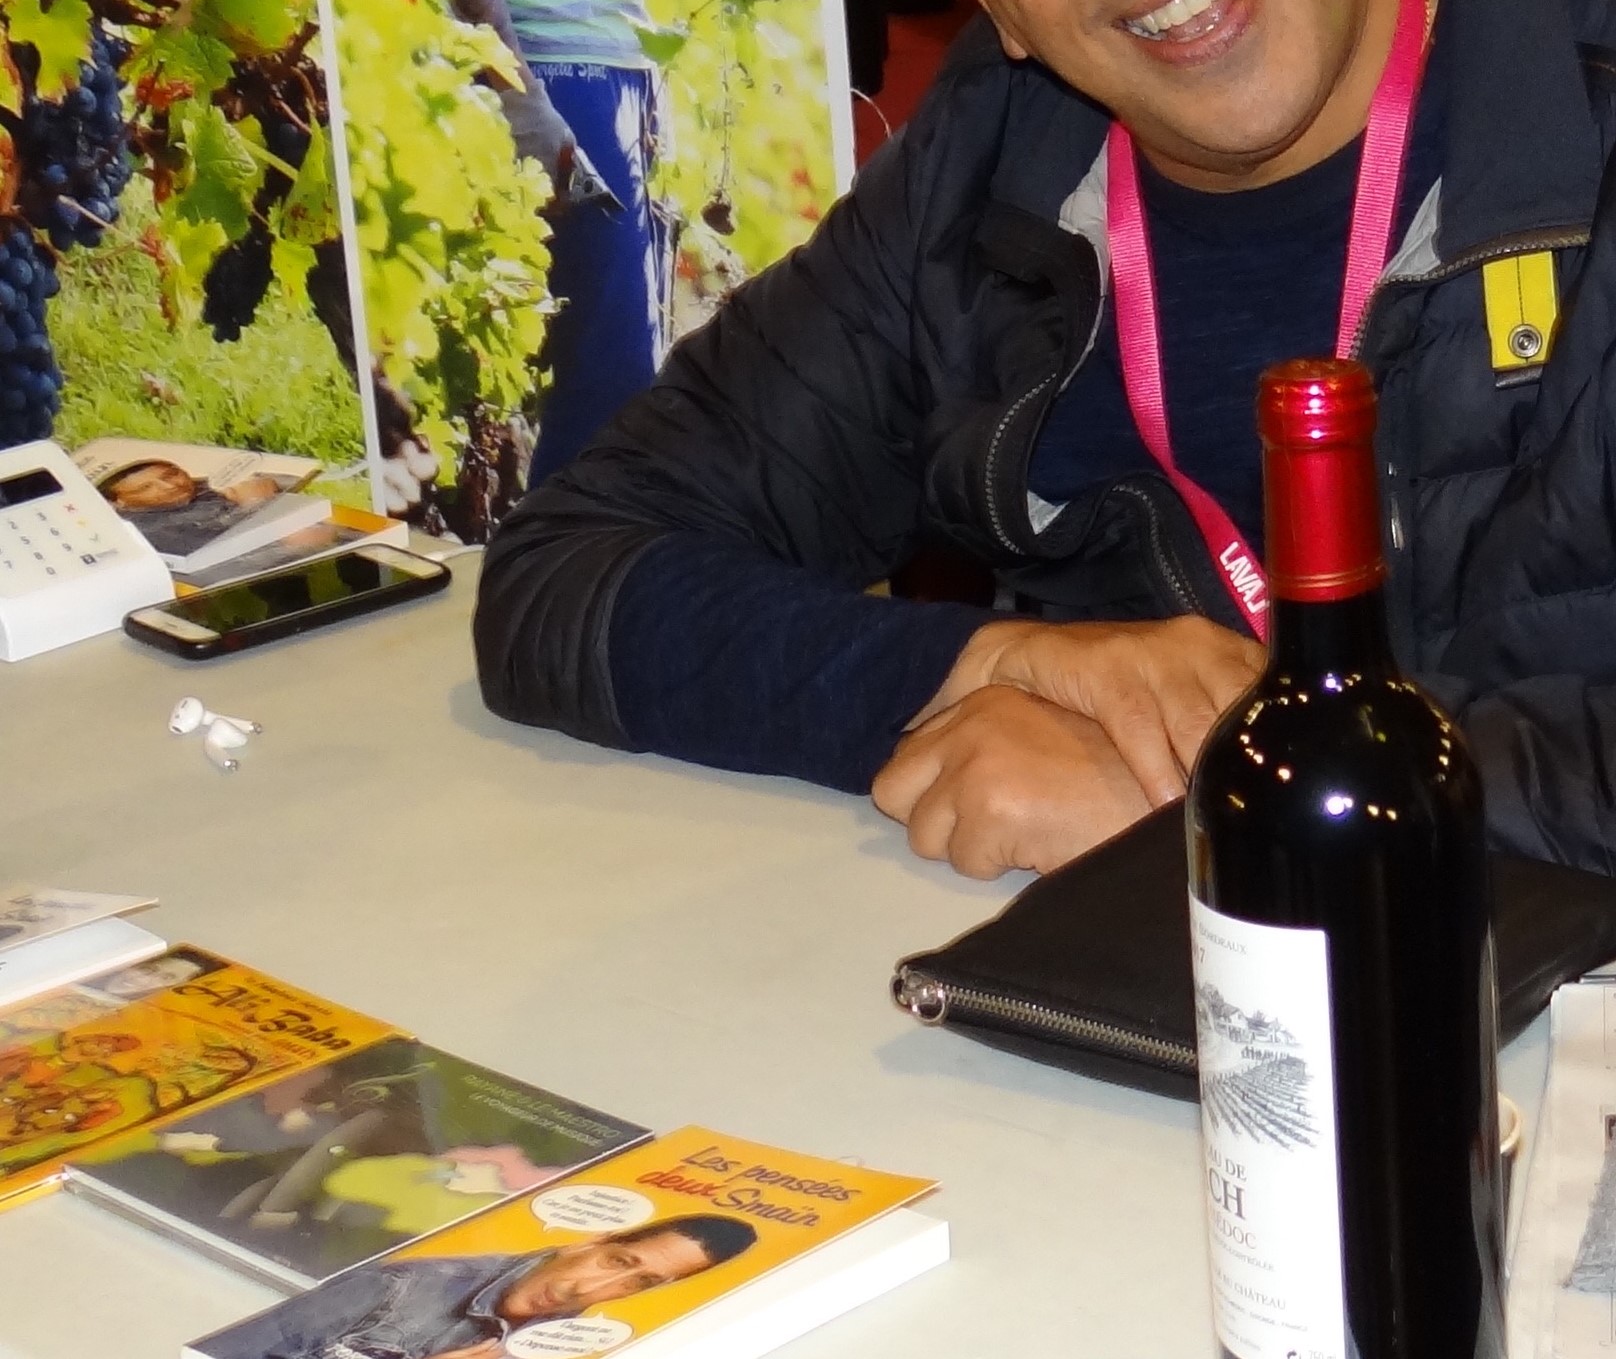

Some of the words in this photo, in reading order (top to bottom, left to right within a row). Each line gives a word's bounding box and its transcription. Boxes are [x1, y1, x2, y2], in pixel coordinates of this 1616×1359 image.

[636, 1166, 729, 1197] deux
[711, 1188, 821, 1227] Smaïn
[679, 1145, 741, 1172] Les
[724, 1164, 862, 1202] pensées
